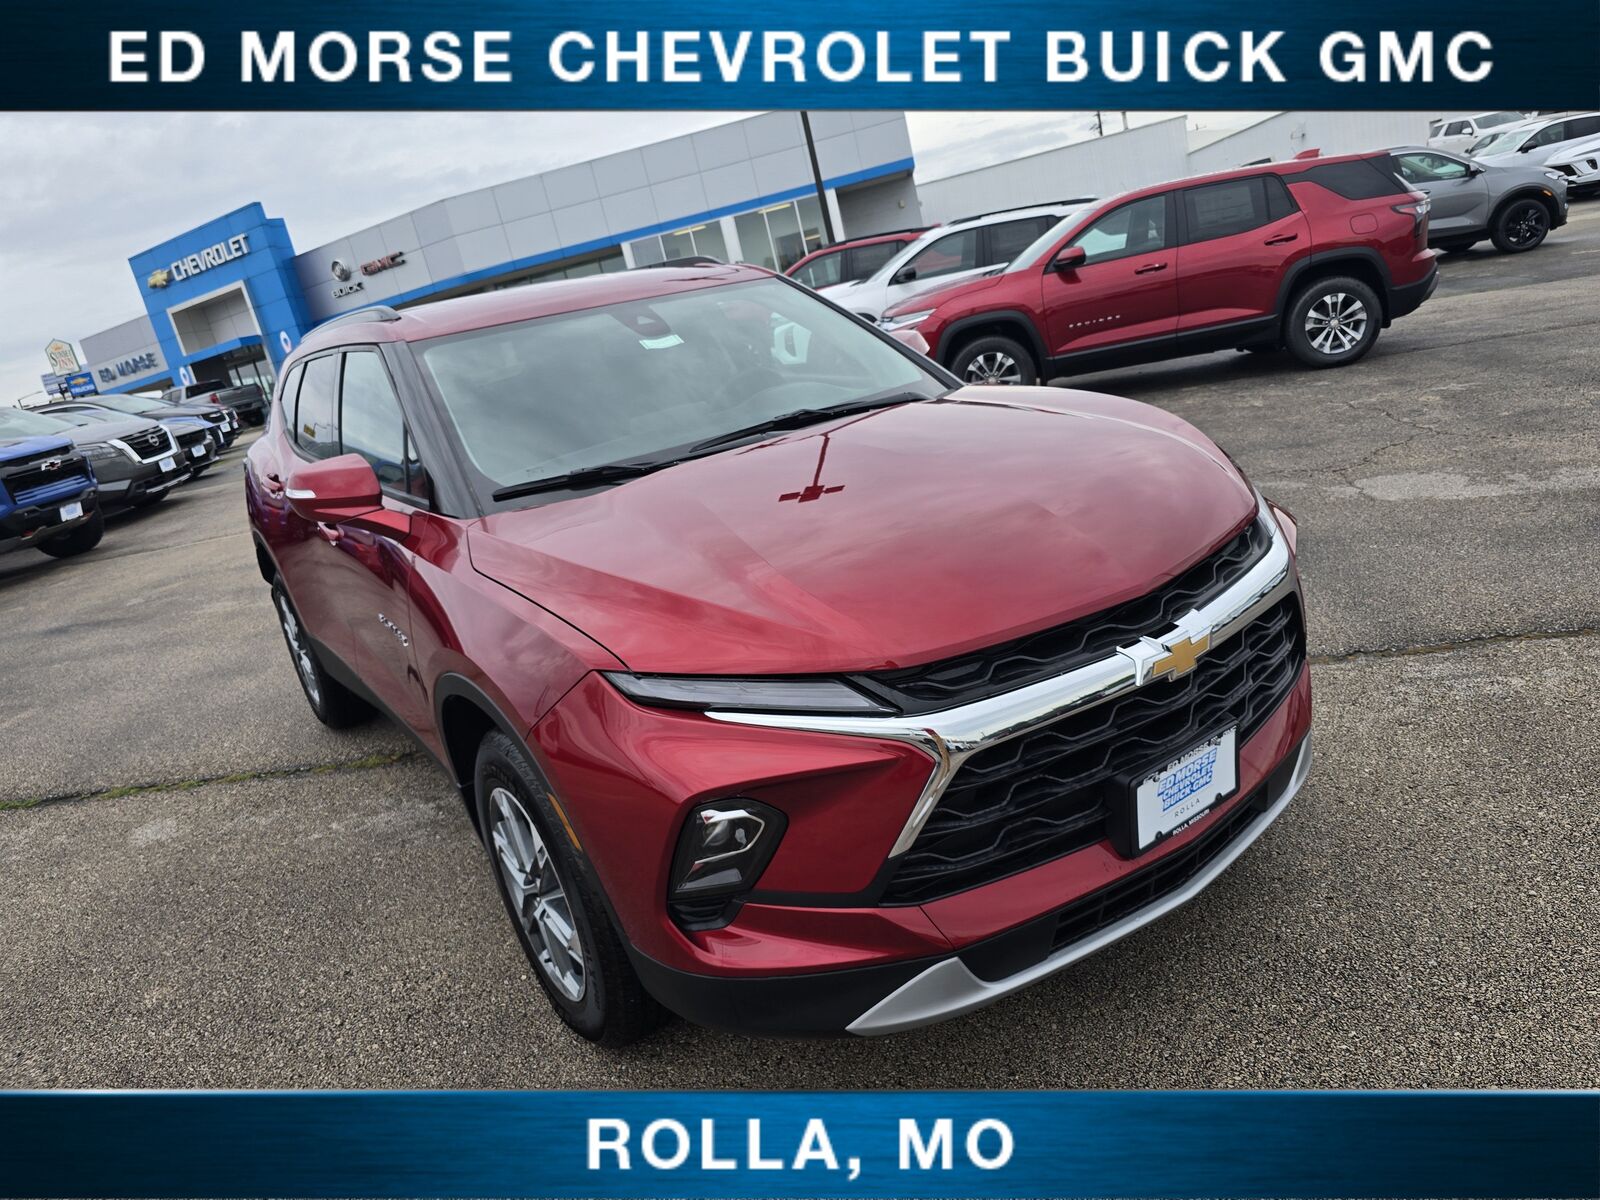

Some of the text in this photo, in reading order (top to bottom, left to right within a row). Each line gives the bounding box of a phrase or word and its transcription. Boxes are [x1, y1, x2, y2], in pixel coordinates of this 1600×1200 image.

[170, 232, 250, 282] CHEVROLET
[1157, 774, 1176, 797] ED
[1175, 748, 1217, 784] MORSE
[1162, 763, 1213, 801] CHEVROLET
[1174, 798, 1200, 818] ROLLA
